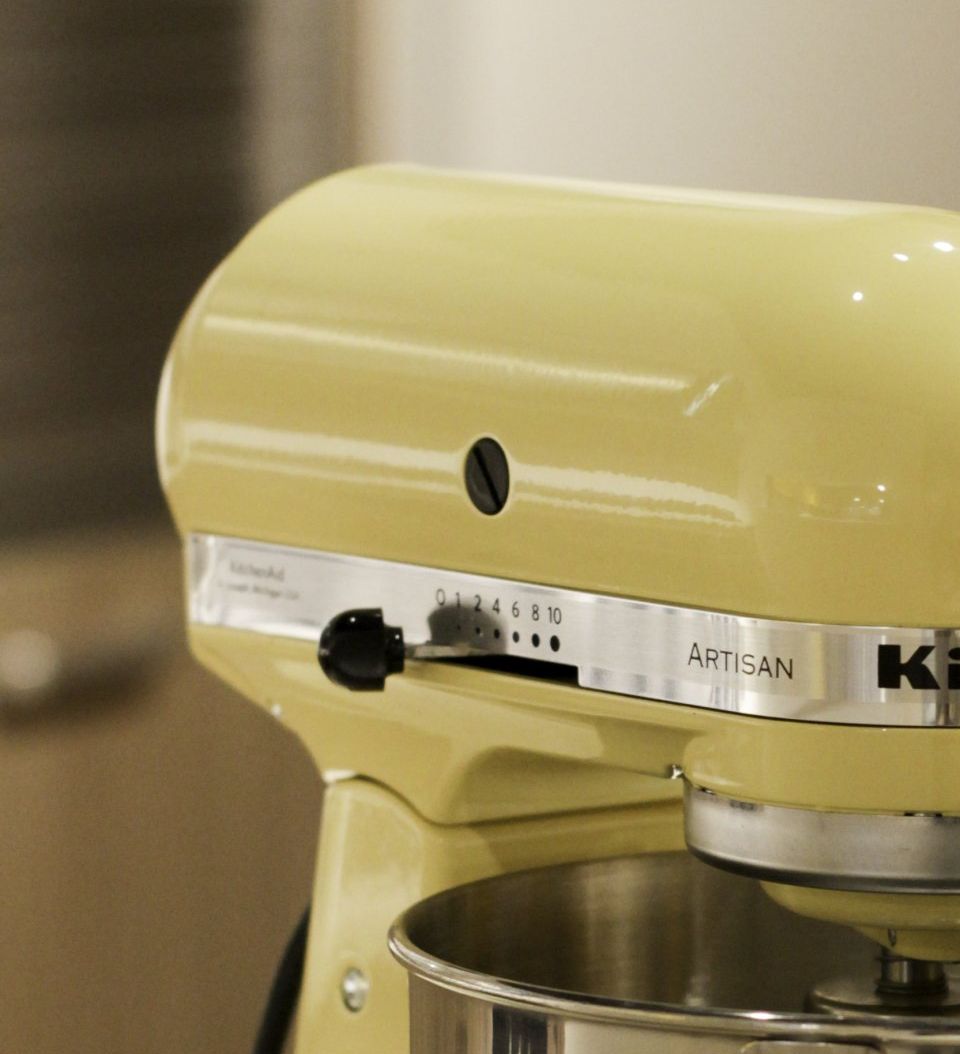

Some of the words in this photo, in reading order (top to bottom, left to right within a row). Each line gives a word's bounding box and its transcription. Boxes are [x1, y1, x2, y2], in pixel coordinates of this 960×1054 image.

[435, 588, 446, 606] 0
[455, 592, 461, 608] 1
[475, 594, 482, 612] 2
[492, 597, 500, 614] 4
[512, 601, 520, 618] 6
[531, 603, 540, 621] 8
[547, 606, 562, 624] 10
[687, 642, 793, 679] ARTISAN
